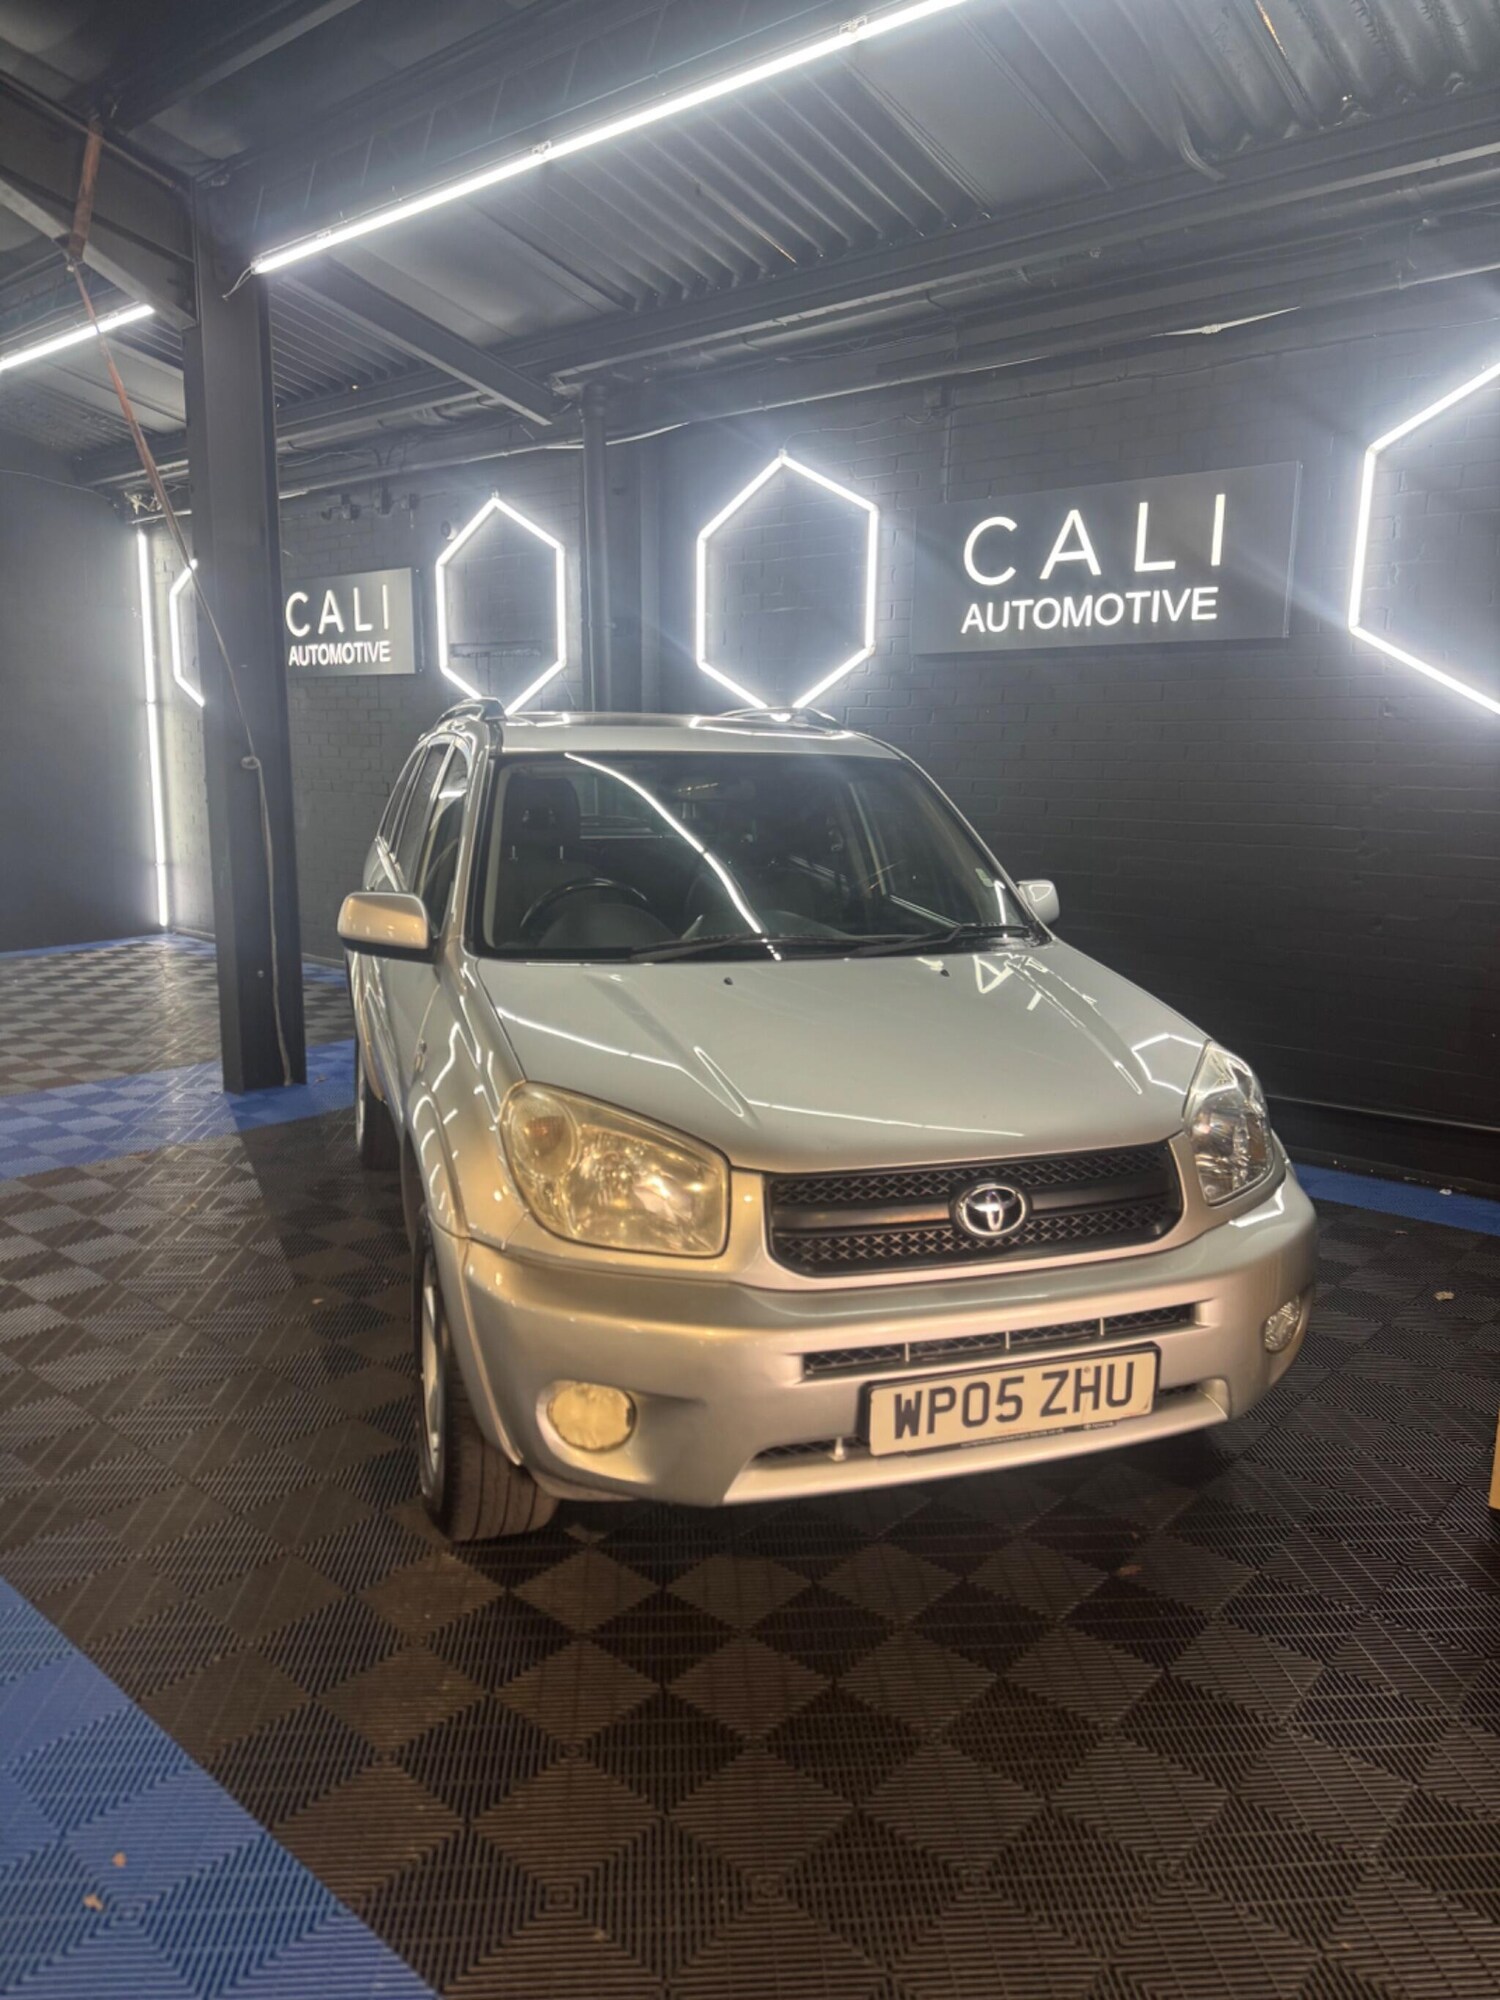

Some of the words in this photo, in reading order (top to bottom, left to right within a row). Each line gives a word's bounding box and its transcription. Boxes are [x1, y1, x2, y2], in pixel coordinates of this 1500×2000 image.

[963, 493, 1226, 586] CALI
[285, 584, 389, 637] CALI
[961, 586, 1220, 634] AUTOMOTIVE
[288, 640, 392, 667] AUTOMOTIVE
[893, 1375, 1025, 1440] WP05
[1039, 1360, 1135, 1418] ZHU
